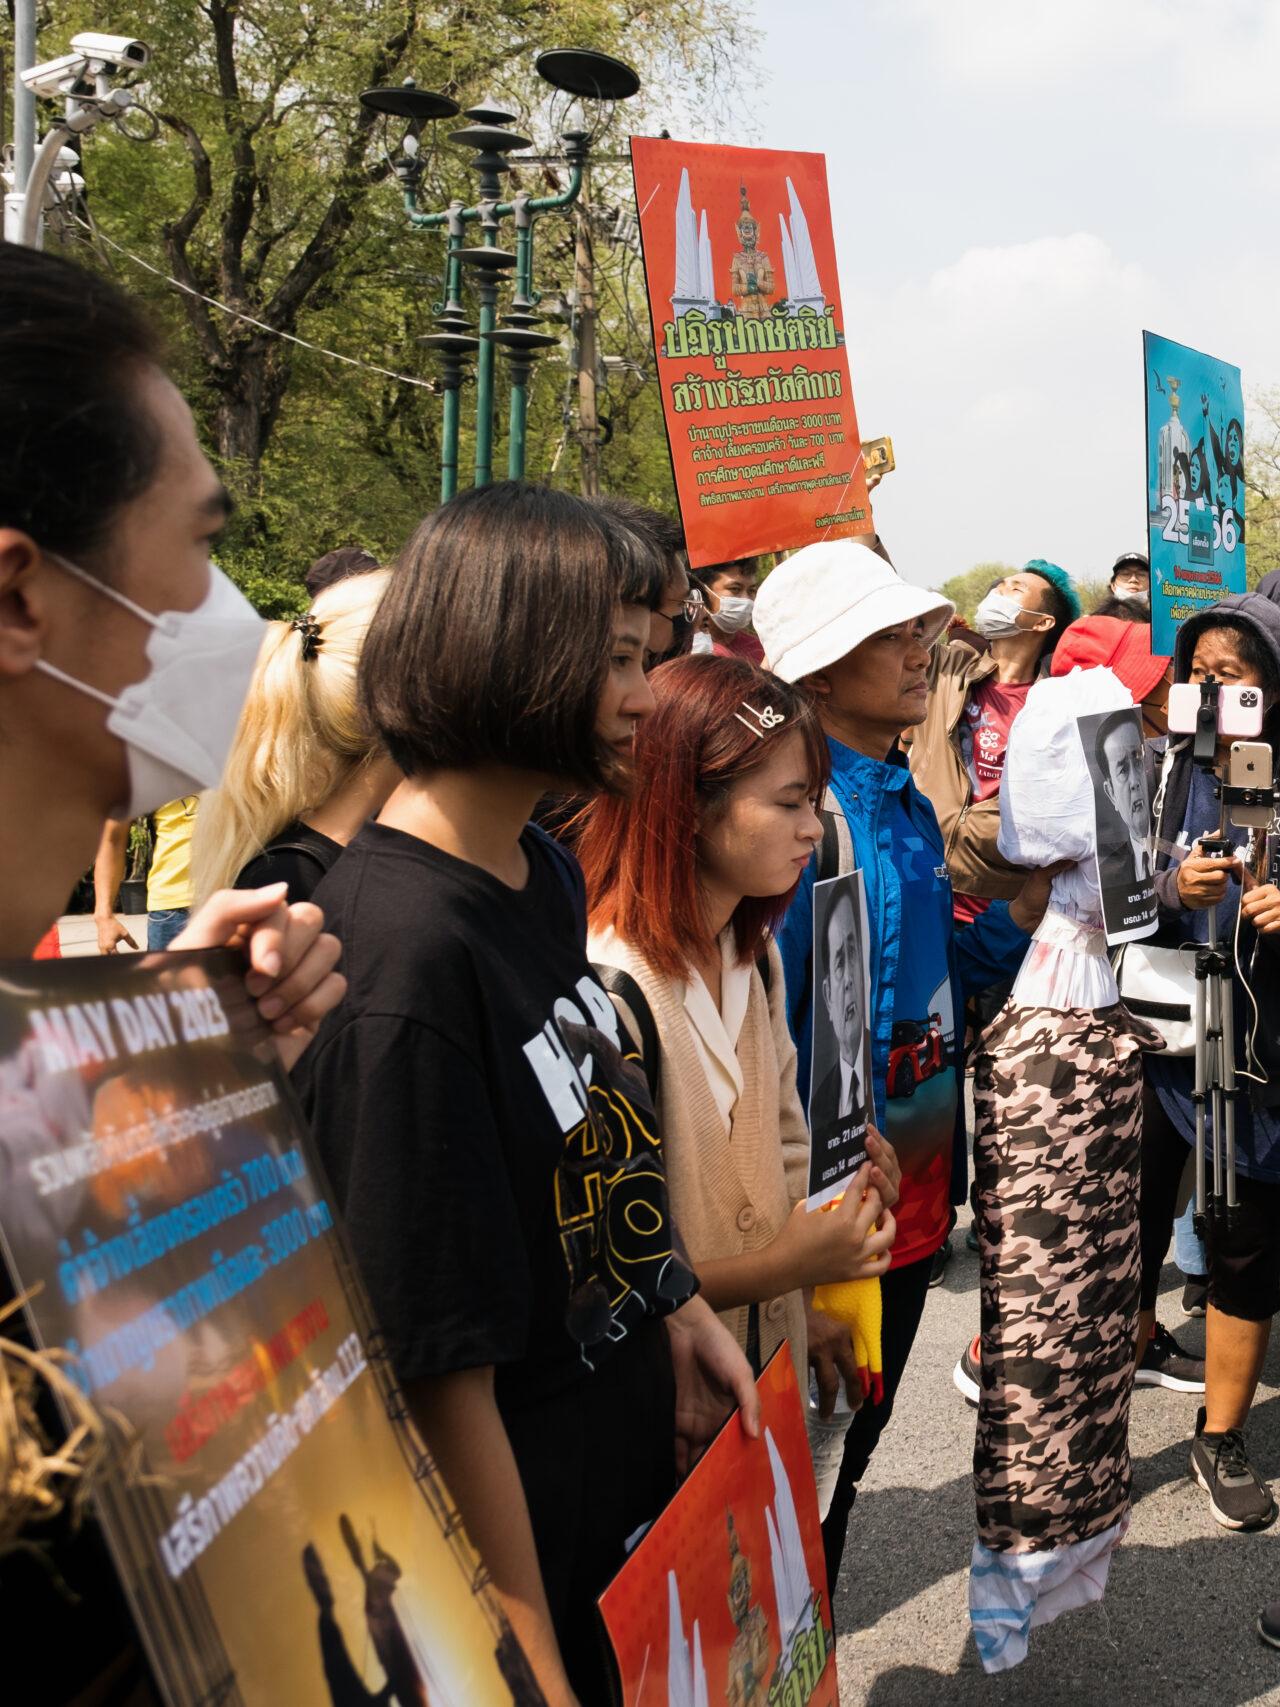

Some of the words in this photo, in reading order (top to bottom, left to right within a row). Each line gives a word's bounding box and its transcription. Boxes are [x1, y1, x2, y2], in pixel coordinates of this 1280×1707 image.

[671, 363, 841, 413] สร้างรัฐสวัสดิการ
[801, 414, 822, 429] 3000
[825, 413, 842, 427] บาท
[809, 434, 825, 446] 700
[828, 432, 844, 445] บาท
[110, 993, 178, 1056] DAY
[170, 987, 230, 1042] 2023
[842, 1128, 850, 1143] 21
[240, 1153, 281, 1203] 700
